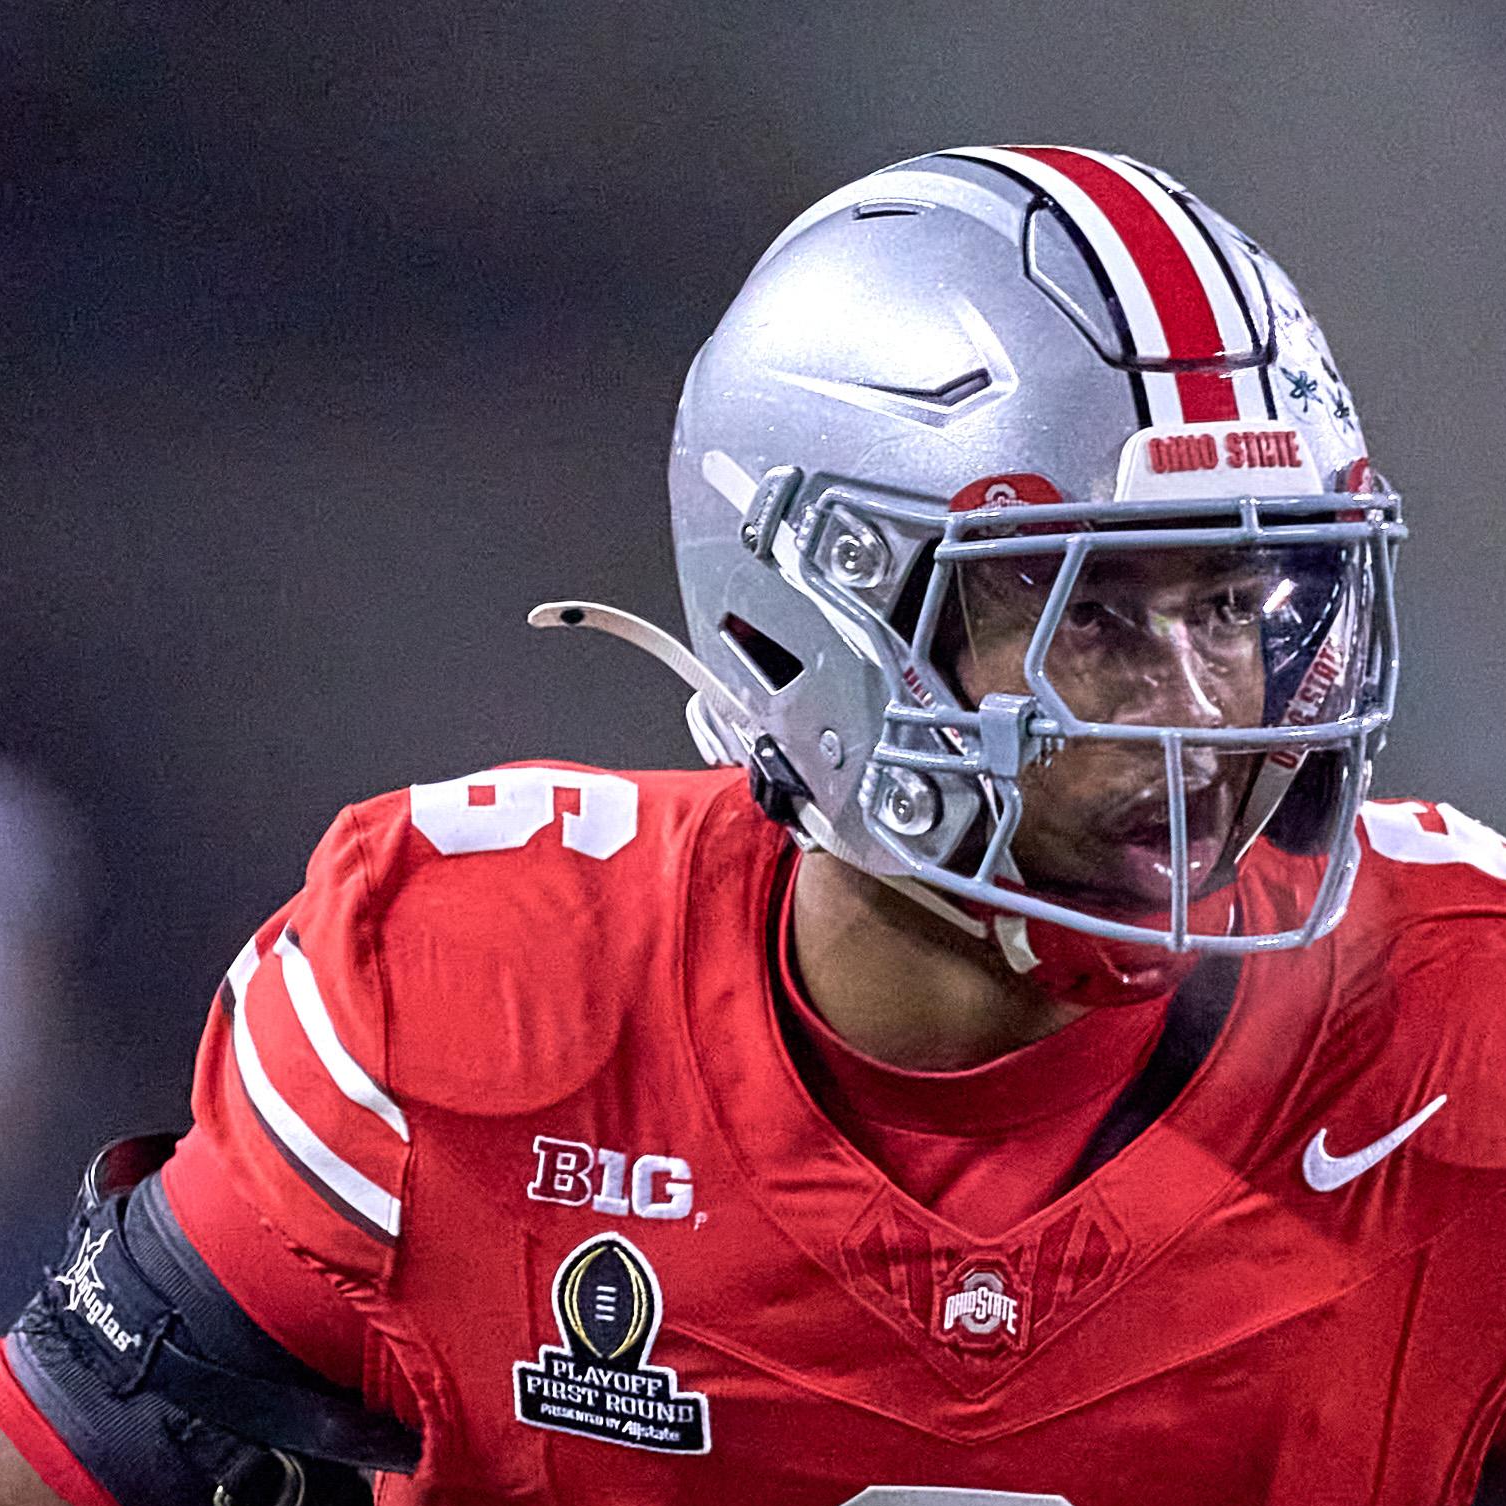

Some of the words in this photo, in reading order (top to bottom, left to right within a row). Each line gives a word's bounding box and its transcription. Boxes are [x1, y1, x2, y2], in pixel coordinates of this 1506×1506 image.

[1148, 433, 1219, 475] OHIO
[1225, 430, 1303, 469] STATE
[409, 767, 639, 860] 6
[526, 1374, 600, 1408] FIRST
[604, 1391, 694, 1423] ROUND
[551, 1358, 663, 1398] PLAYOFF
[621, 1419, 682, 1441] Allstate
